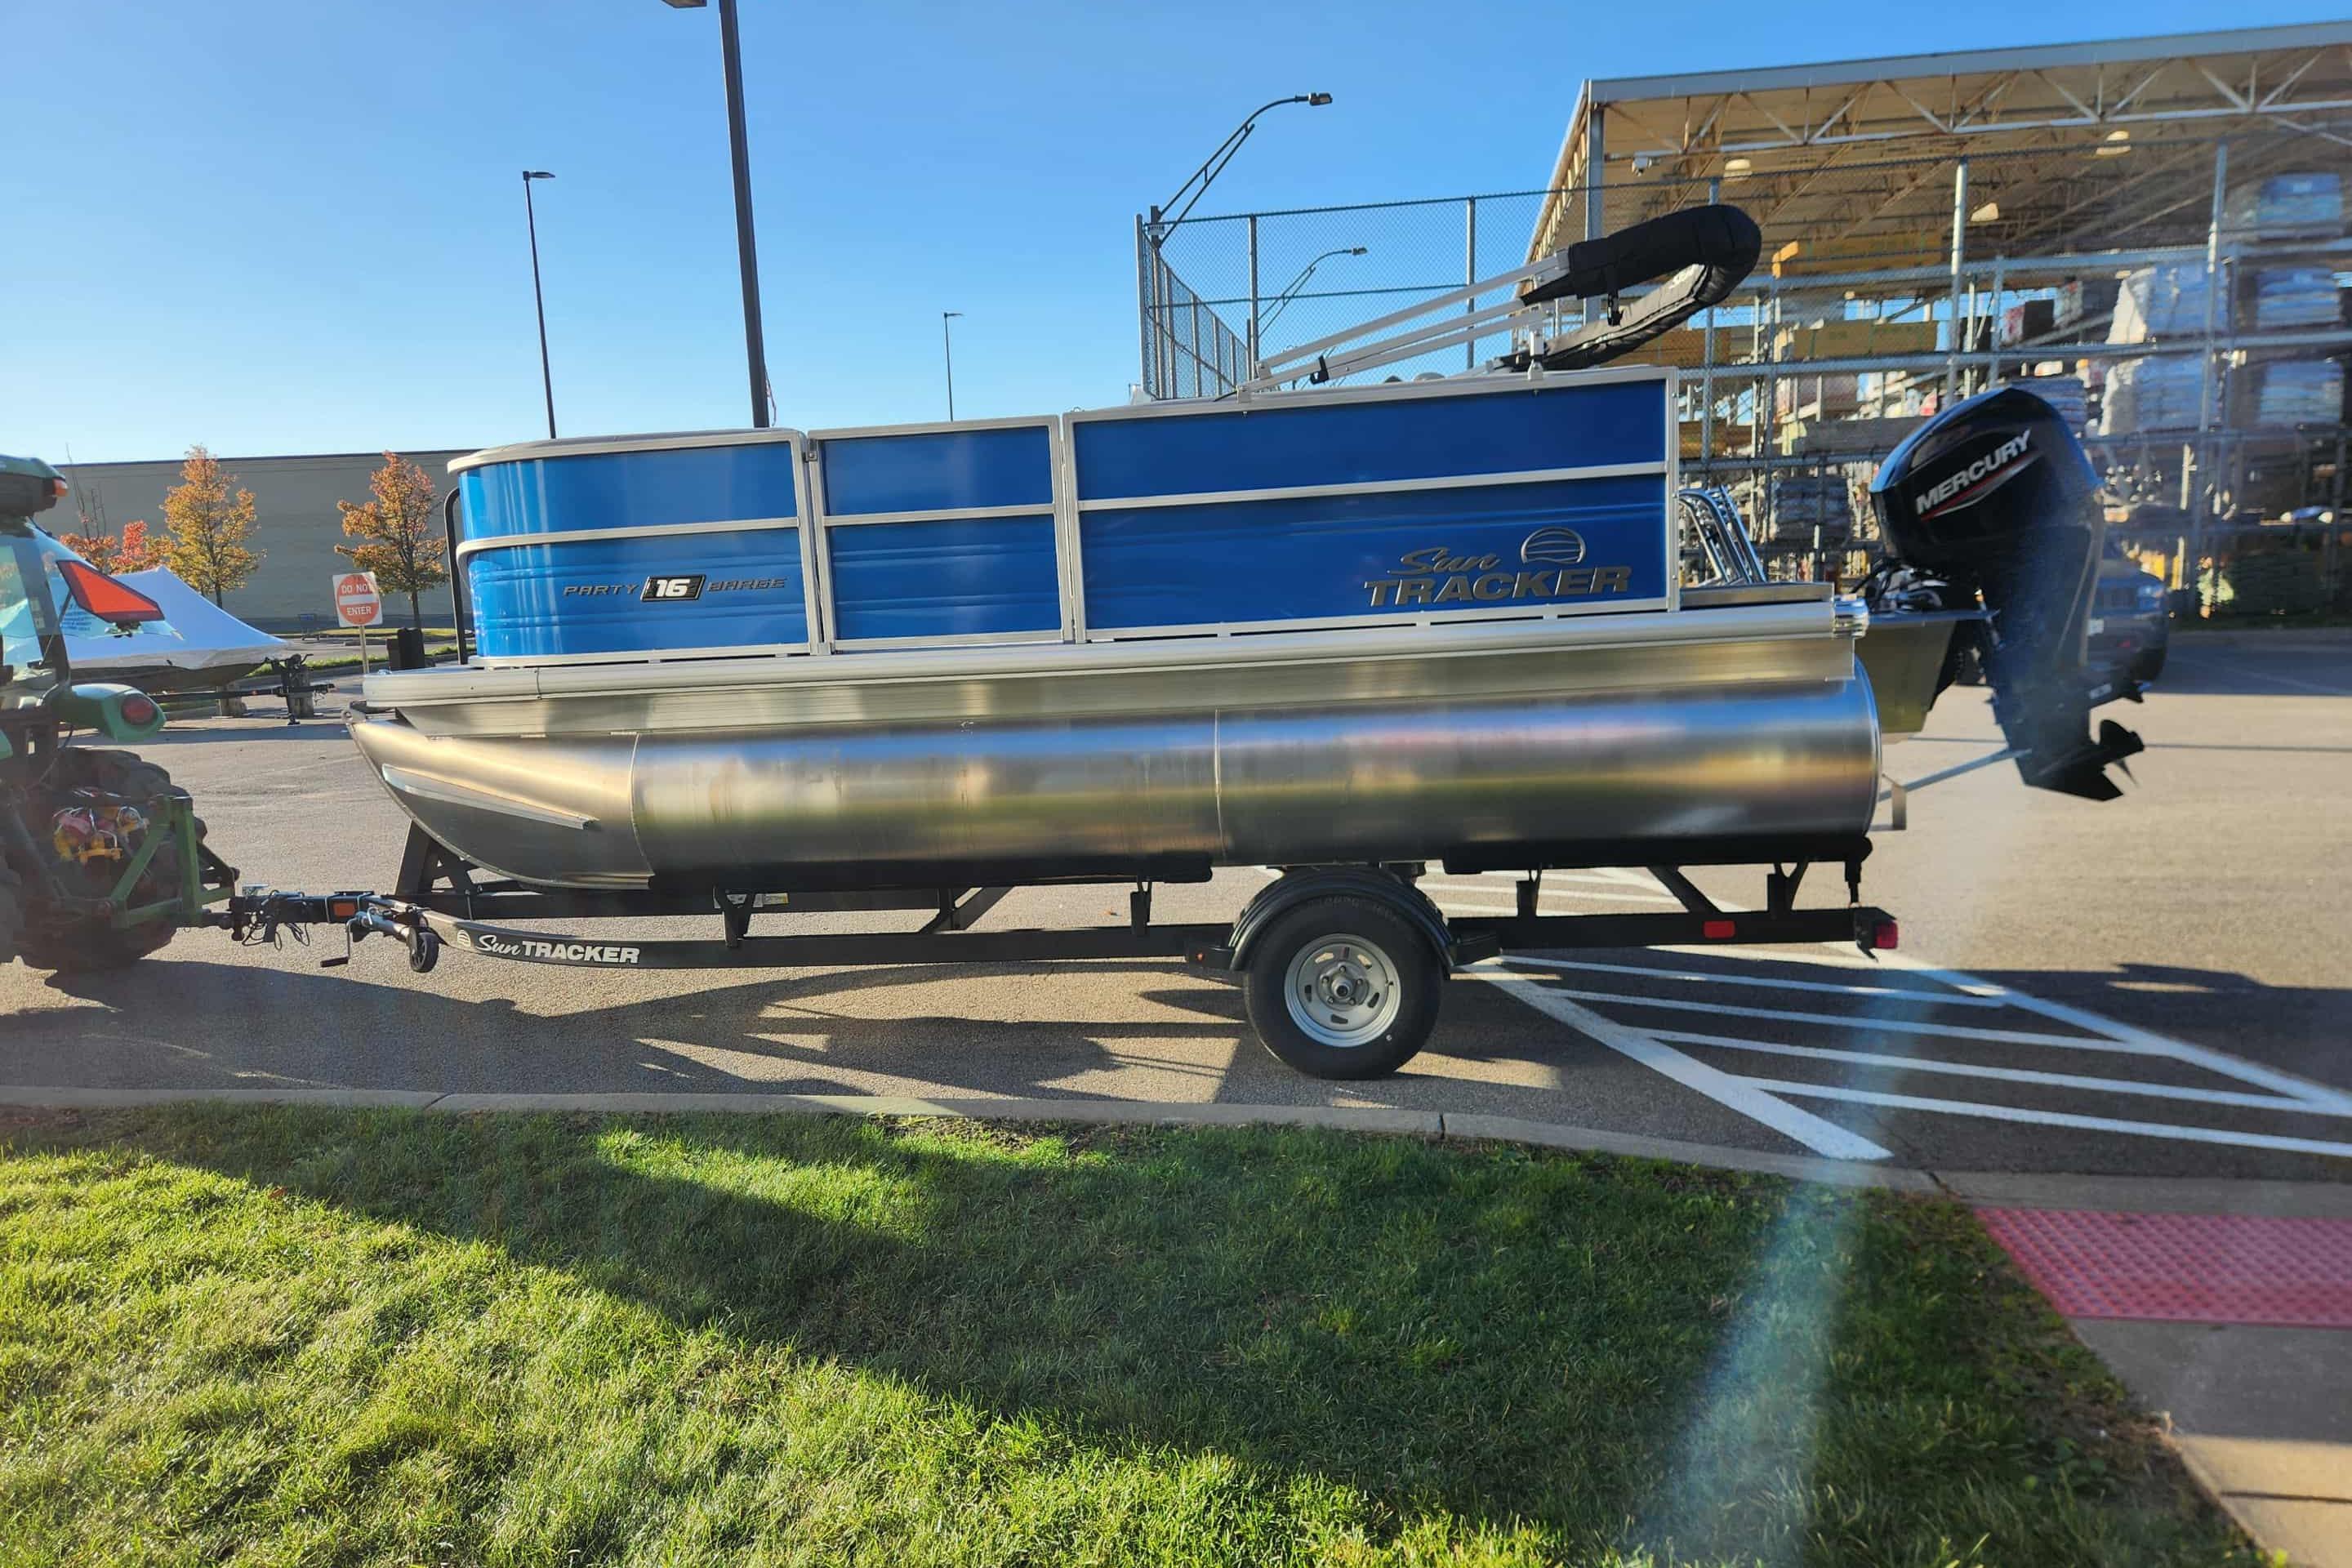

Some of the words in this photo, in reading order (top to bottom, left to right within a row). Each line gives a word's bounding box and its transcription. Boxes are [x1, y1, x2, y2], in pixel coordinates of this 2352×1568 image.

[1916, 429, 2032, 514] MERCURY
[1387, 546, 1501, 576] Sun
[341, 584, 353, 594] DO
[564, 584, 639, 596] PARTY
[656, 578, 691, 597] 16
[708, 578, 786, 592] BARGE
[1364, 566, 1632, 608] TRACKER
[346, 606, 372, 616] ENTER
[476, 934, 520, 956] Sun
[522, 941, 640, 964] TRACKER
